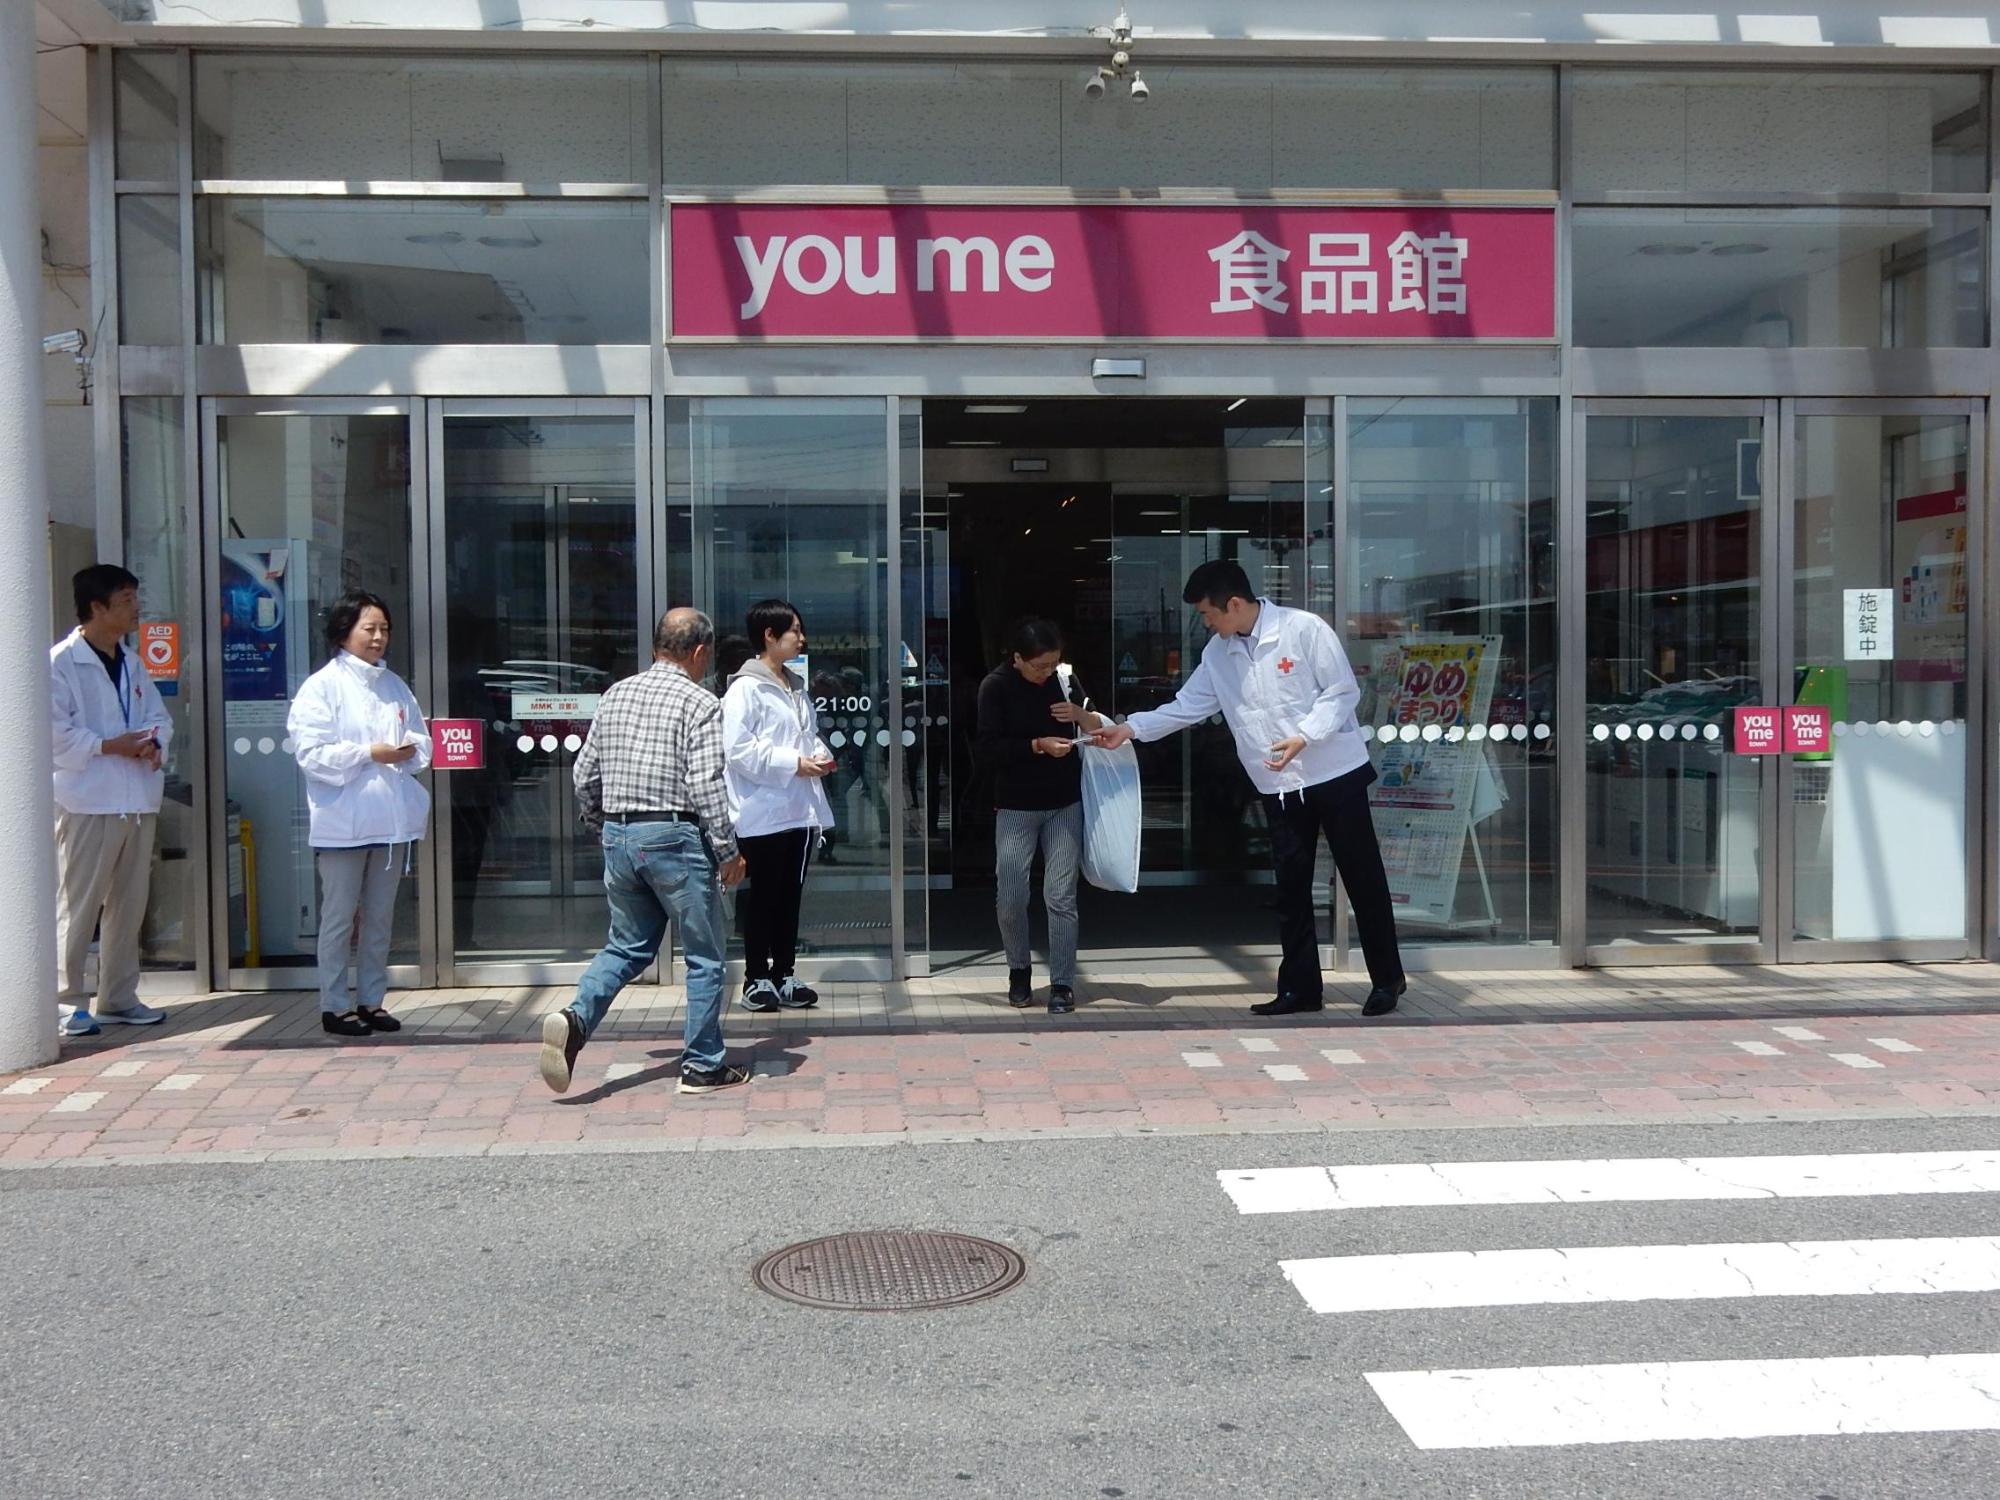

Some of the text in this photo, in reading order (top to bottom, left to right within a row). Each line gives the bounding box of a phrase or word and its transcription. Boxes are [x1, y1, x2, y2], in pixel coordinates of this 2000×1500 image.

[733, 230, 1469, 320] you me 食品館
[147, 626, 173, 636] AED
[1858, 592, 1878, 656] 施錠中
[1403, 660, 1466, 698] ゆめ
[1397, 699, 1460, 726] まつり
[1743, 716, 1772, 732] you
[1792, 714, 1820, 730] you
[440, 728, 472, 745] you
[1748, 728, 1774, 740] me
[1797, 727, 1823, 738] me
[447, 741, 474, 754] me
